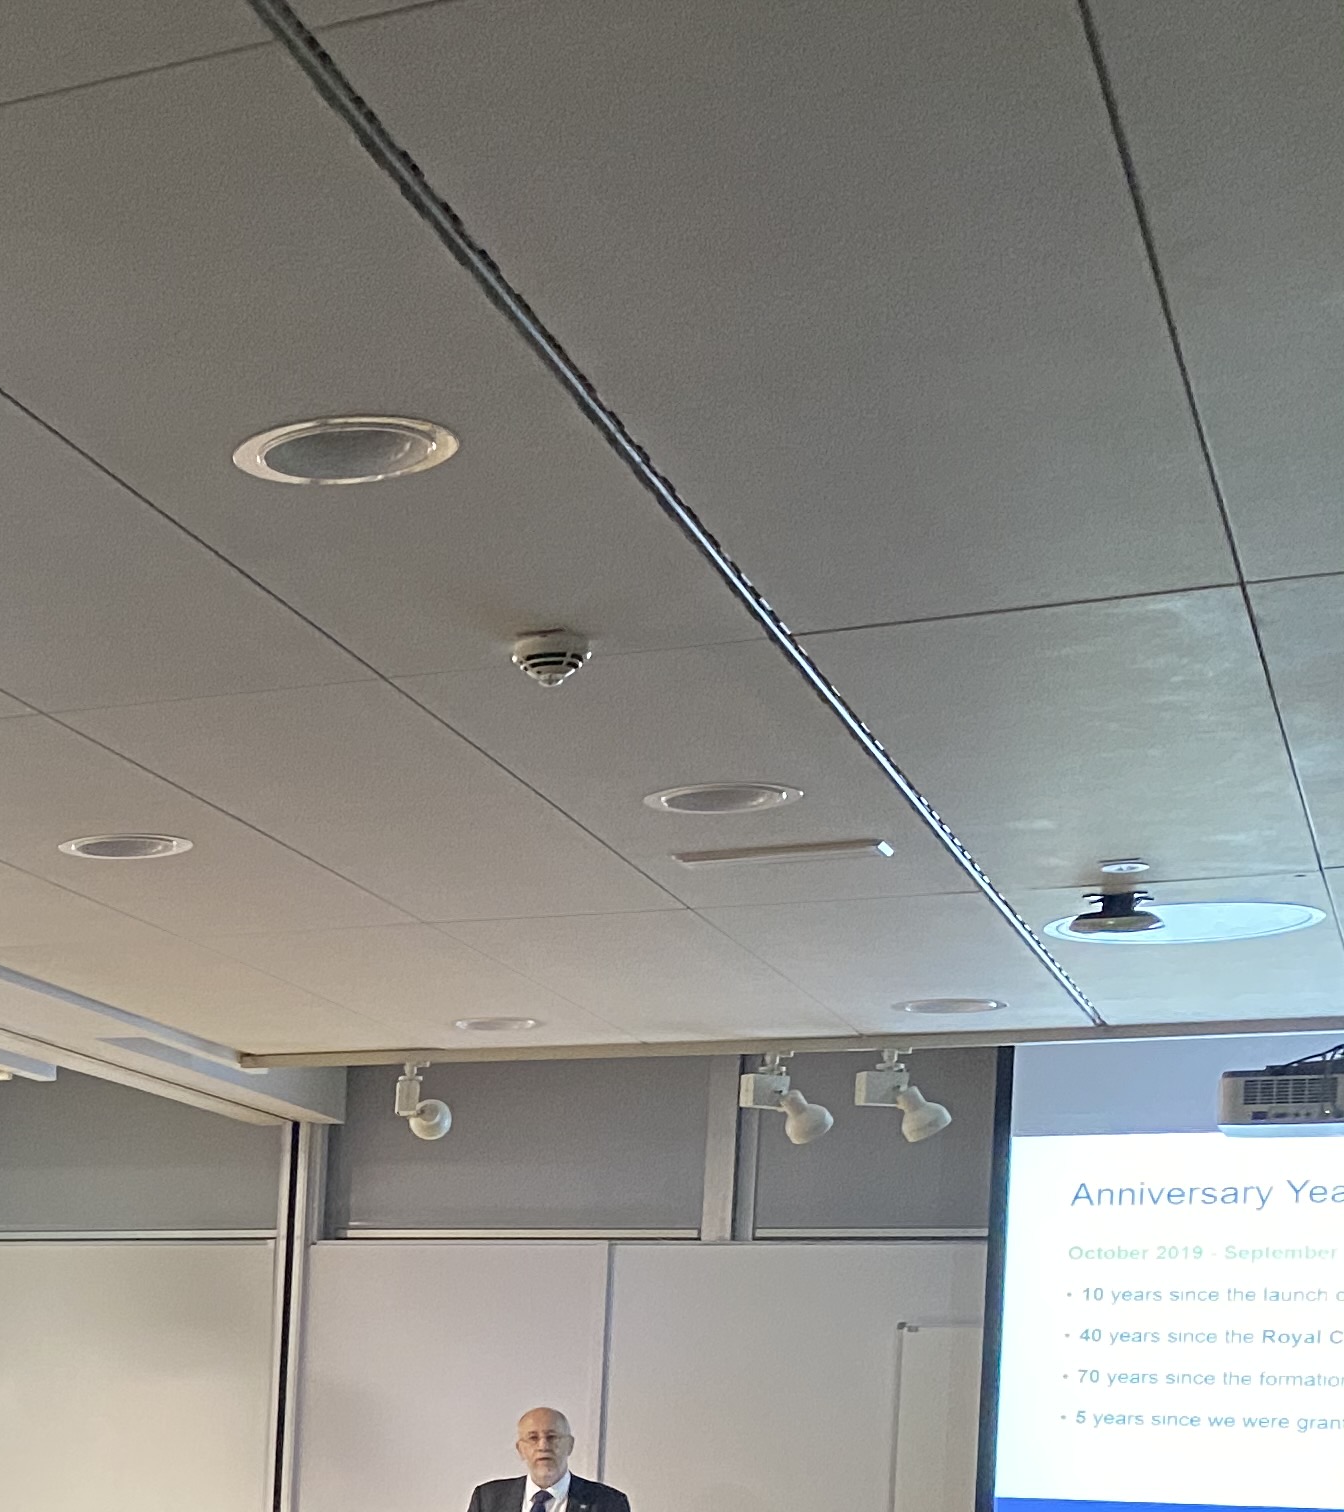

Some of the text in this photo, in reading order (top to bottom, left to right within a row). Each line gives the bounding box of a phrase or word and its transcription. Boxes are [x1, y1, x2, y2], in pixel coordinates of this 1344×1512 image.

[1071, 1179, 1344, 1211] Anniversary Yea
[1068, 1246, 1149, 1260] October
[1156, 1246, 1203, 1260] 2019
[1225, 1245, 1337, 1263] September
[1083, 1288, 1103, 1301] 10
[1112, 1290, 1162, 1305] years
[1169, 1289, 1219, 1301] since
[1227, 1288, 1255, 1301] the
[1264, 1287, 1328, 1301] launch
[1080, 1329, 1101, 1341] 40
[1109, 1331, 1160, 1345] years
[1168, 1332, 1217, 1343] since
[1225, 1330, 1254, 1343] the
[1262, 1329, 1321, 1348] Royal
[1078, 1369, 1099, 1383] 70
[1107, 1373, 1158, 1387] years
[1166, 1373, 1215, 1385] since
[1223, 1372, 1251, 1385] the
[1076, 1411, 1344, 1433] 5 years since we were gran
